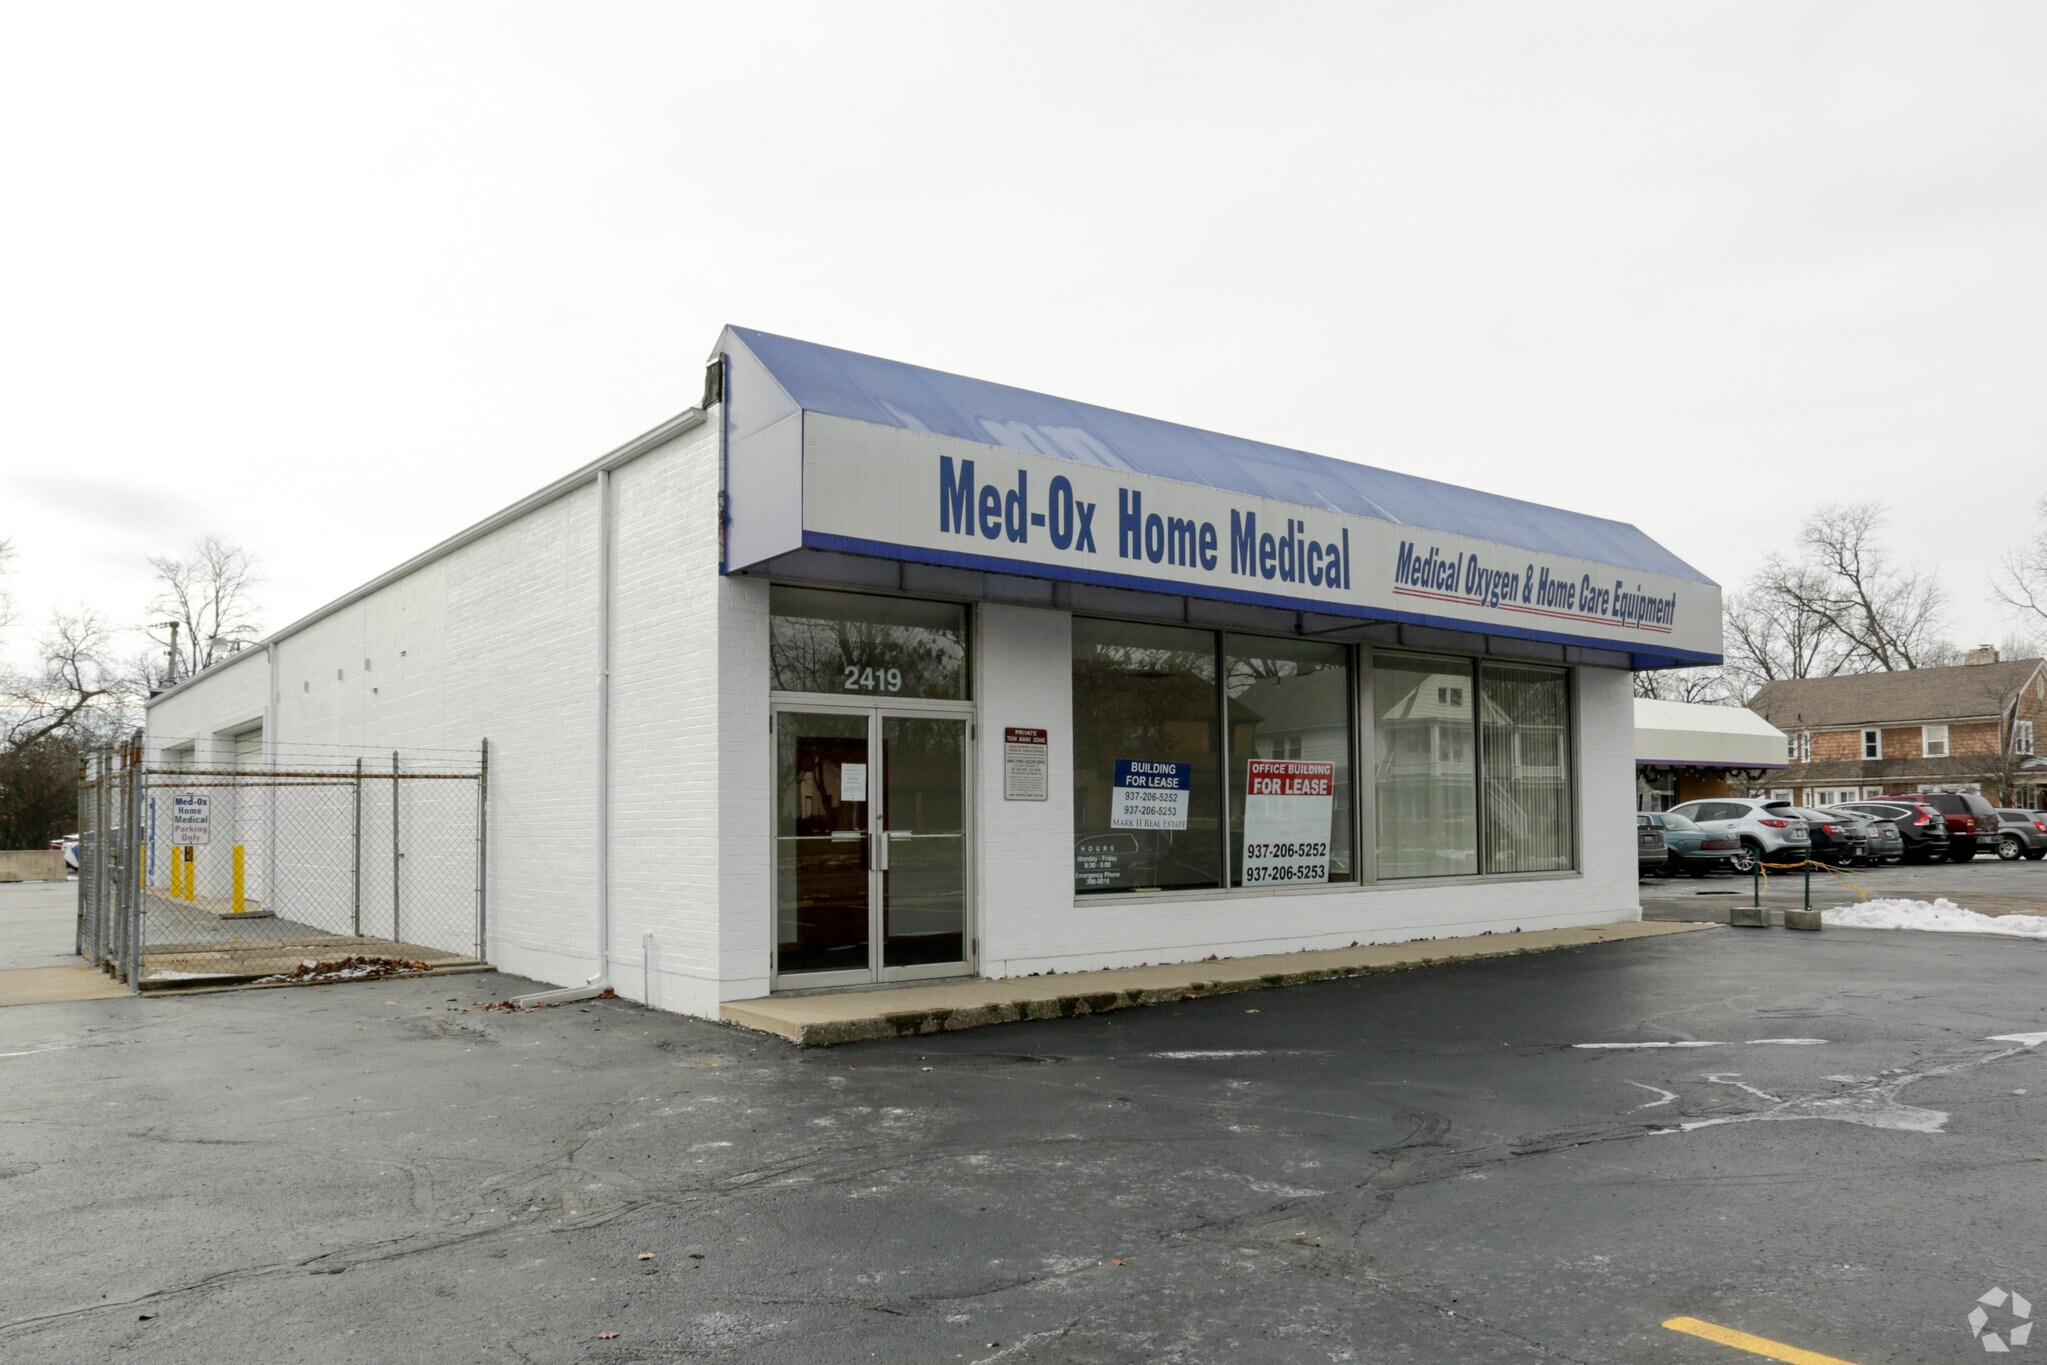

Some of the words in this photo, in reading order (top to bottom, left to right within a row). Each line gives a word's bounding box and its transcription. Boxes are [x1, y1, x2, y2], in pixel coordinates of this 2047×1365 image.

[940, 455, 1097, 553] Med-Ox
[1119, 488, 1218, 571] Home
[1230, 508, 1350, 590] Medical
[1395, 541, 1463, 592] Medical
[1464, 554, 1519, 608] Oxygen
[1522, 564, 1534, 604] &
[1536, 566, 1576, 610] Home
[1579, 574, 1610, 615] Care
[1611, 580, 1676, 629] Equipment
[844, 665, 902, 692] 2419
[1131, 762, 1176, 774] BUILDING
[1252, 763, 1285, 774] OFFICE
[1288, 765, 1331, 775] BUILDING
[1126, 775, 1146, 787] FOR
[1148, 777, 1179, 788] LEASE
[1253, 778, 1282, 794] FOR
[1285, 778, 1328, 795] LEASE
[175, 797, 207, 806] Med-Ox
[1125, 791, 1178, 802] 937-206-5252
[178, 806, 202, 815] Home
[1124, 805, 1177, 816] 937-206-5253
[175, 815, 208, 824] Medical
[1112, 818, 1134, 827] MARK
[1144, 819, 1160, 828] REAL
[1163, 819, 1186, 829] ESTATE
[175, 825, 208, 834] Parking
[181, 833, 200, 842] Only
[1247, 842, 1326, 859] 937-206-5252
[1101, 854, 1117, 862] Friday
[1246, 865, 1325, 881] 937-206-5253
